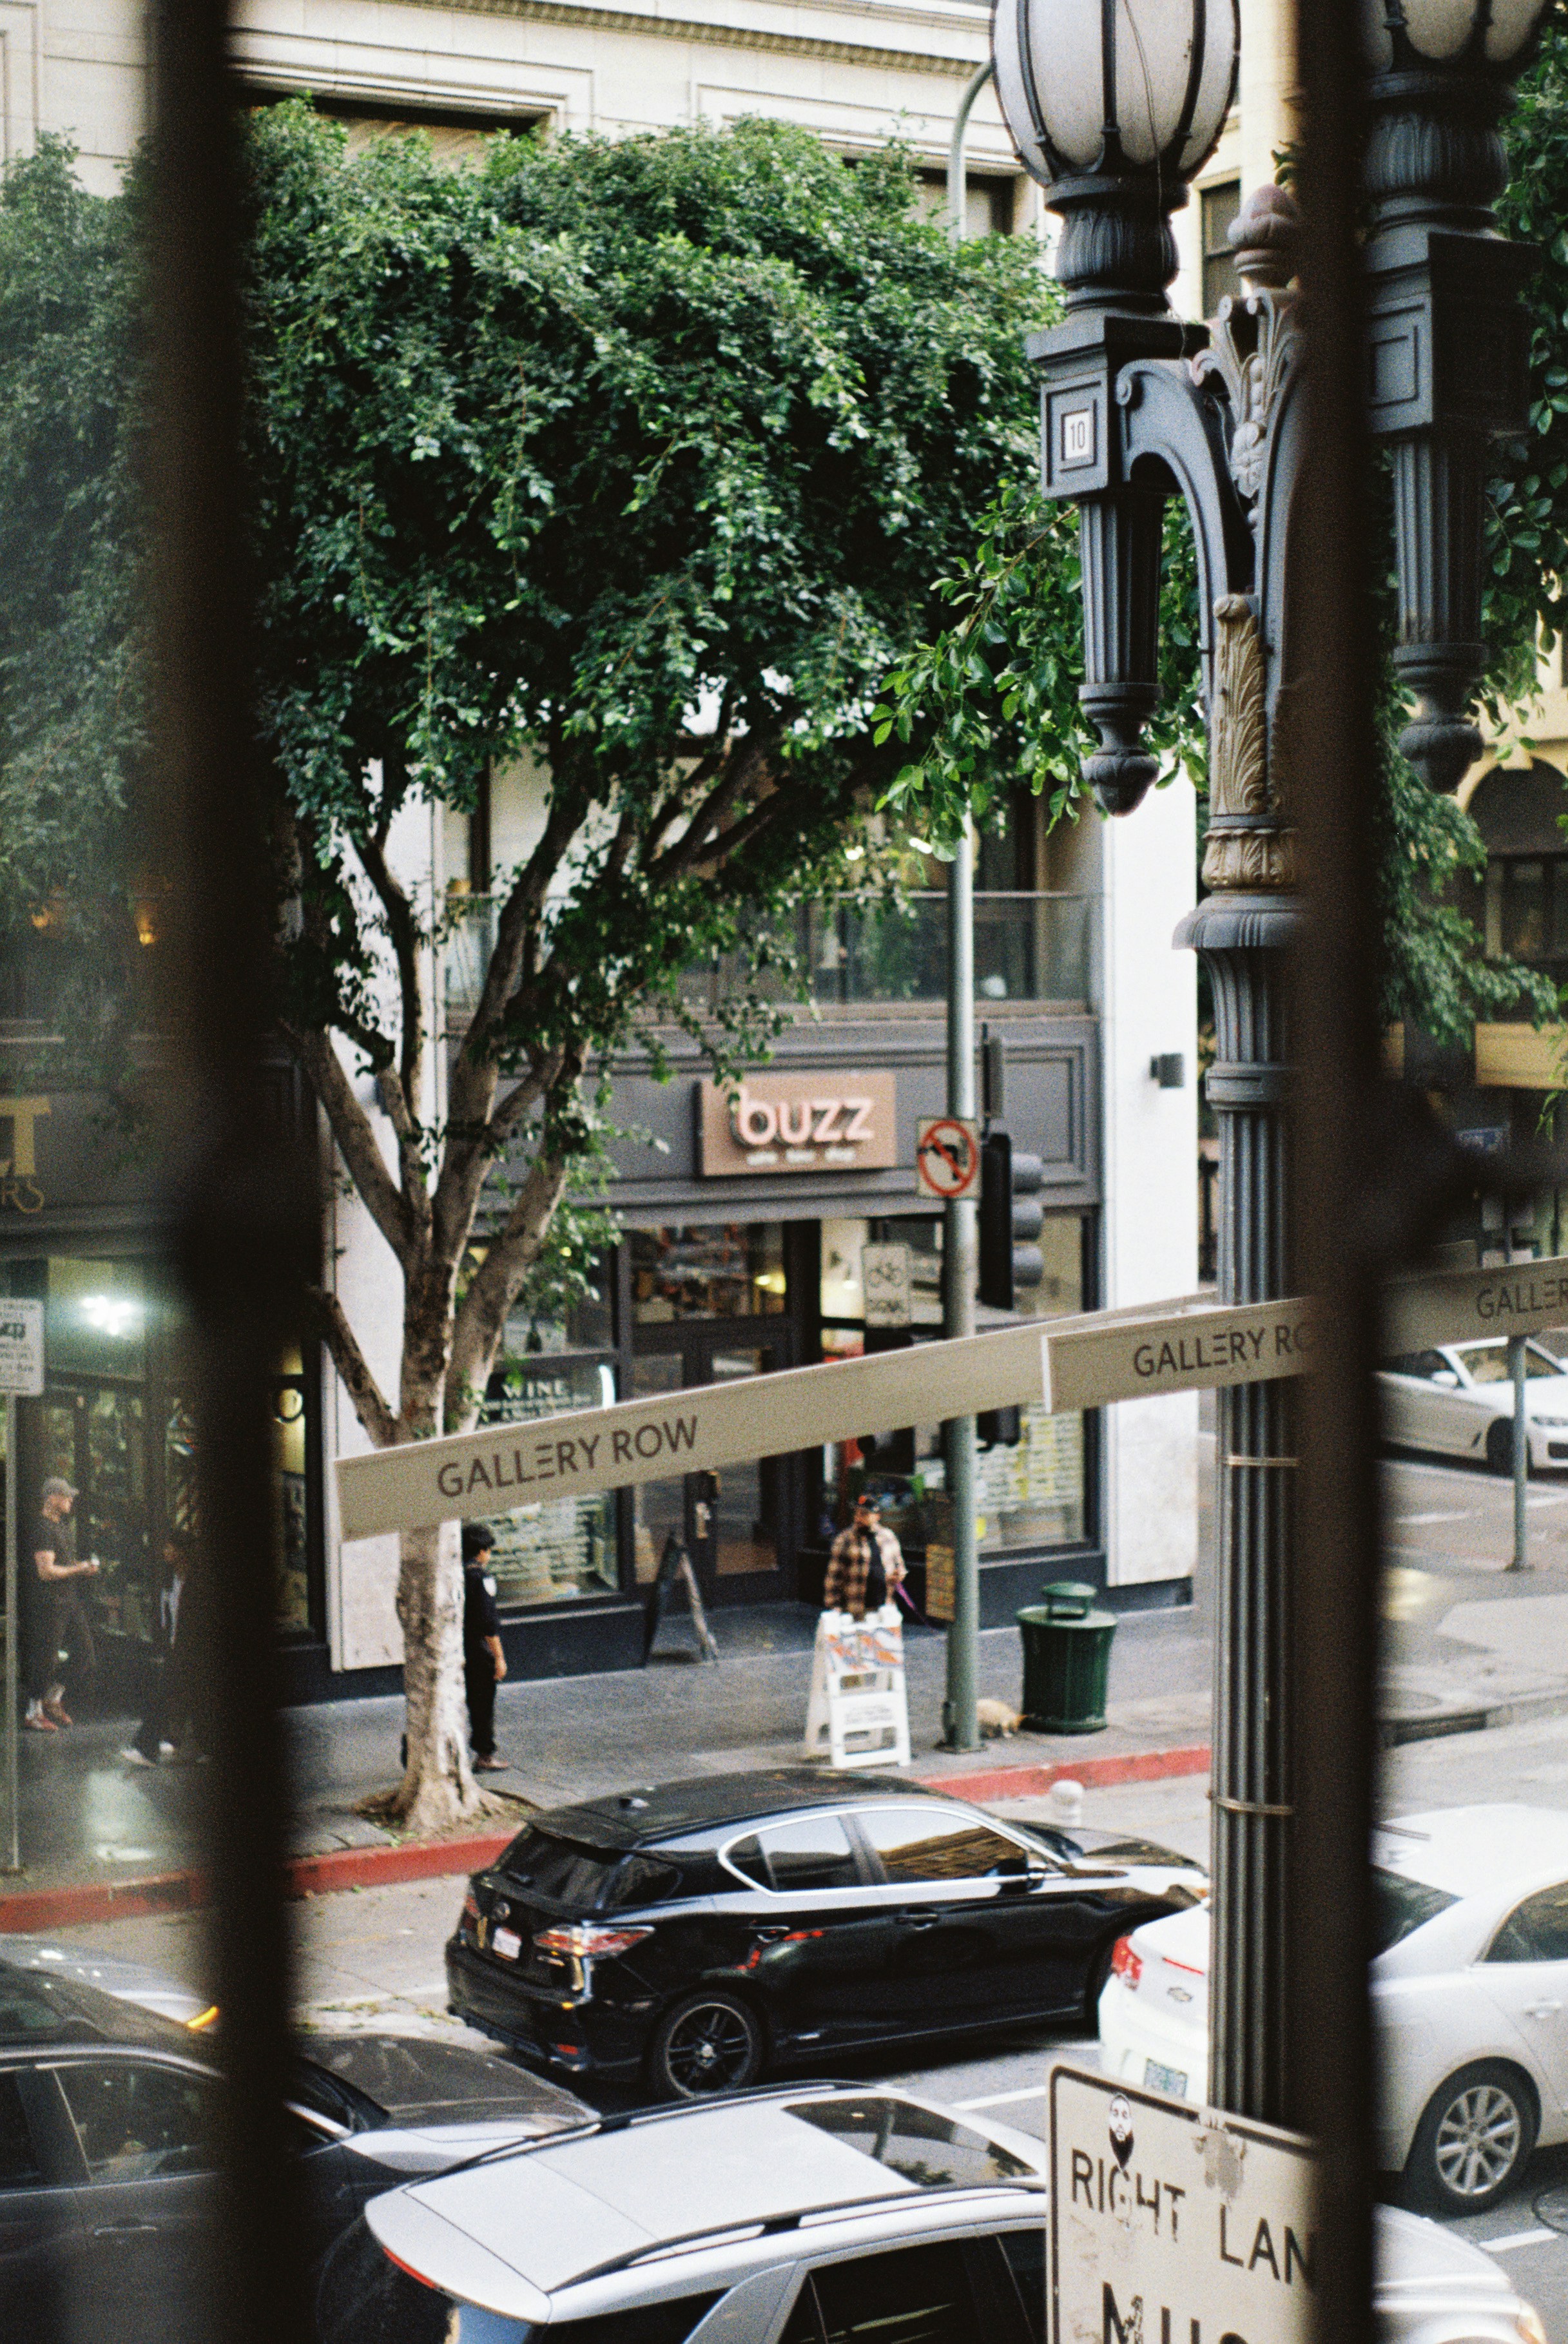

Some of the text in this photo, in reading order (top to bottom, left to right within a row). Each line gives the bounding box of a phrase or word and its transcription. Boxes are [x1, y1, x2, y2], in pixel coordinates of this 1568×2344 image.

[1070, 420, 1085, 450] 10
[0, 1096, 50, 1176] T
[737, 1084, 875, 1145] buzz
[1133, 1327, 1266, 1377] GALLERY
[437, 1416, 698, 1498] GALLERY ROW
[1071, 2148, 1185, 2243] RIGHT
